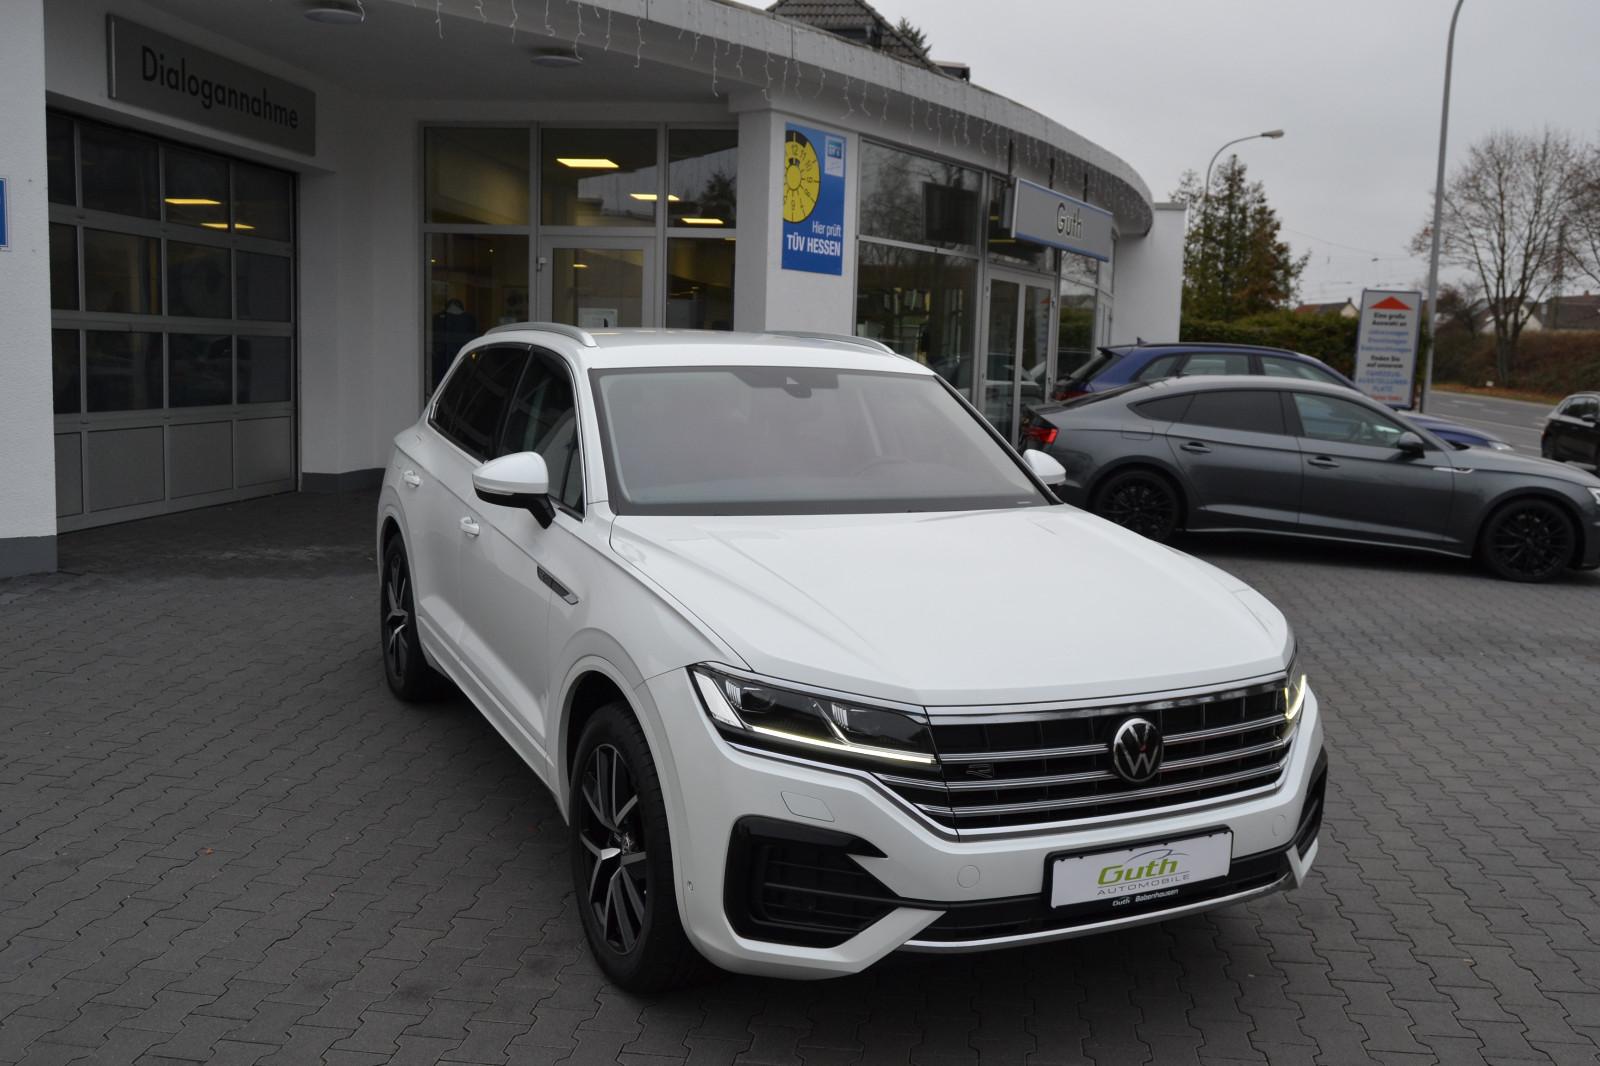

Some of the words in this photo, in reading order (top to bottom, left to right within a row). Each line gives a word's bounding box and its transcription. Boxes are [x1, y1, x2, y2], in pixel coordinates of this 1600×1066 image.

[142, 45, 298, 129] Dialogannahme
[812, 220, 825, 235] Hier
[826, 224, 842, 237] prüft
[1056, 202, 1082, 239] Guth
[786, 232, 805, 251] TÜV
[807, 237, 841, 257] HESSEN
[1097, 857, 1179, 885] Guth
[1097, 873, 1191, 896] AUTOMOBILE
[1112, 897, 1131, 907] Guth
